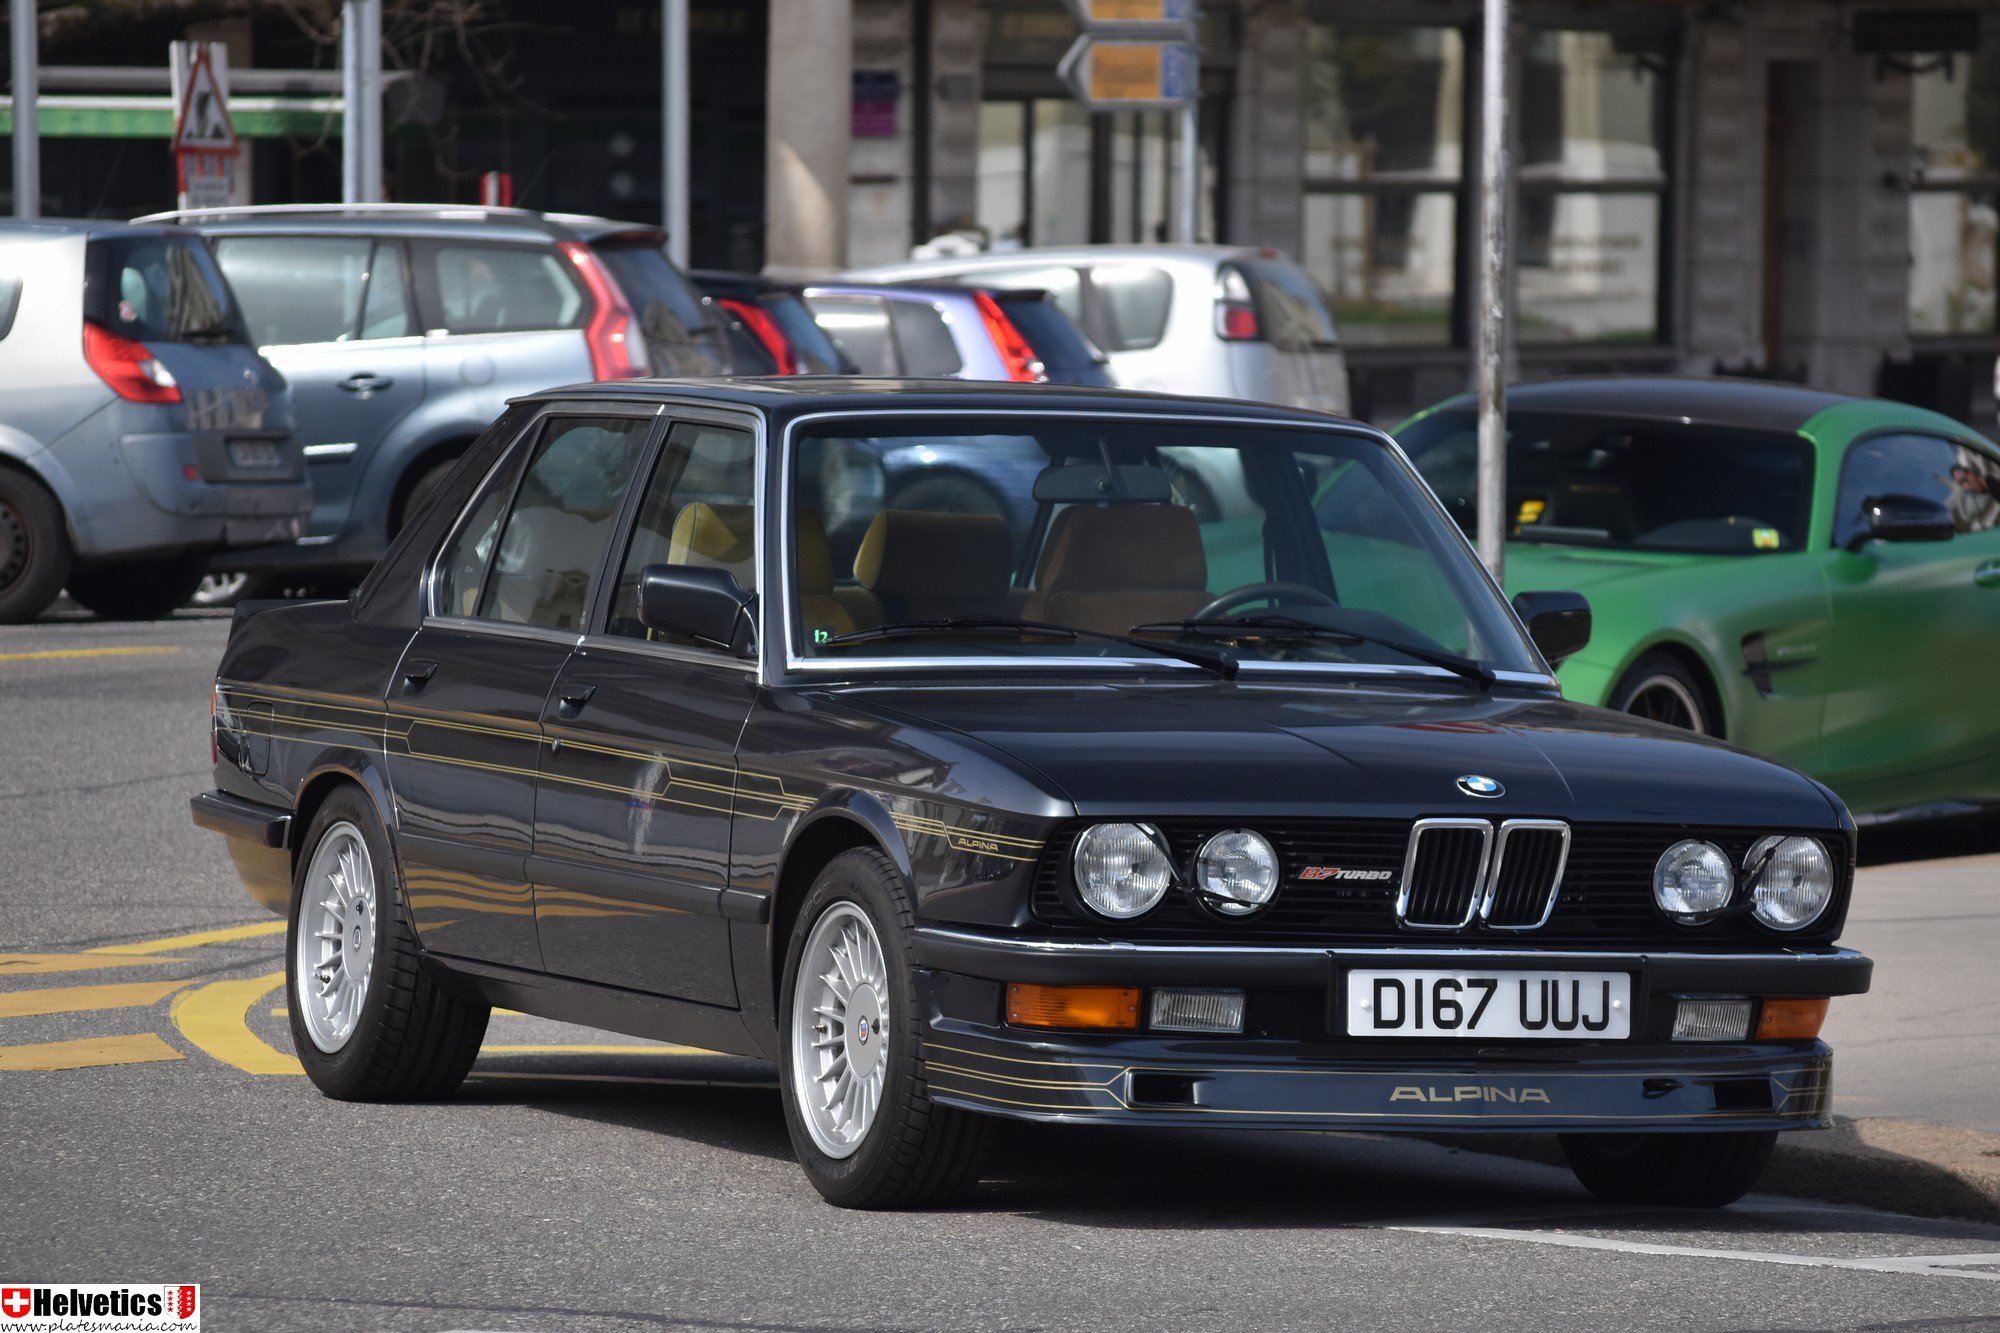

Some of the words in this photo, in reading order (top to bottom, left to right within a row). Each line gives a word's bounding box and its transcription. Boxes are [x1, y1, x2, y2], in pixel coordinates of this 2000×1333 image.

[957, 837, 999, 852] ALPINA
[1334, 870, 1393, 880] TURBO
[1372, 977, 1498, 1031] D167
[1518, 979, 1611, 1032] UUJ
[1389, 1086, 1551, 1104] ALPINA
